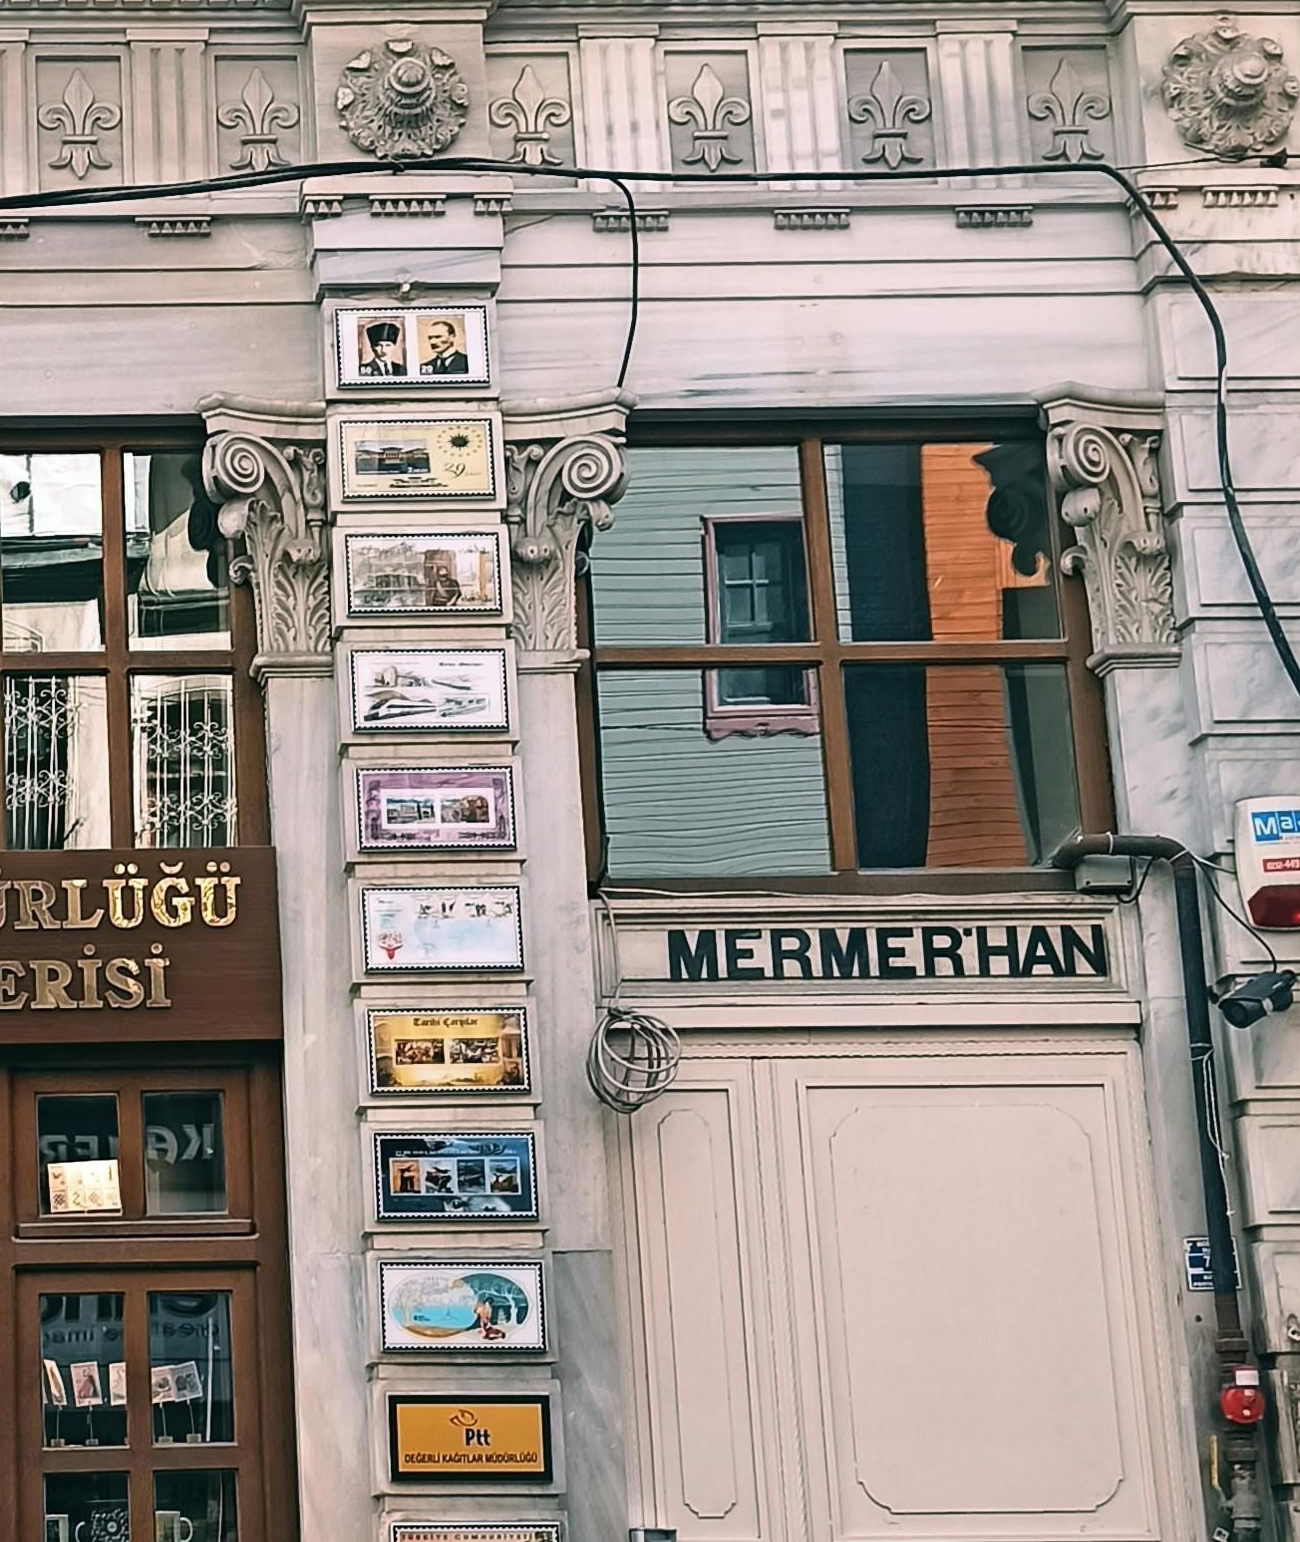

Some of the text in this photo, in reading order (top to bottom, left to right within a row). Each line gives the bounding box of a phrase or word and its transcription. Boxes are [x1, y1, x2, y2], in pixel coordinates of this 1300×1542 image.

[1254, 816, 1300, 836] Ma
[465, 1428, 491, 1446] Ptt
[404, 1452, 537, 1464] DEĞERLİ KAĞITLAR MÜDÜRLÜĞÜ
